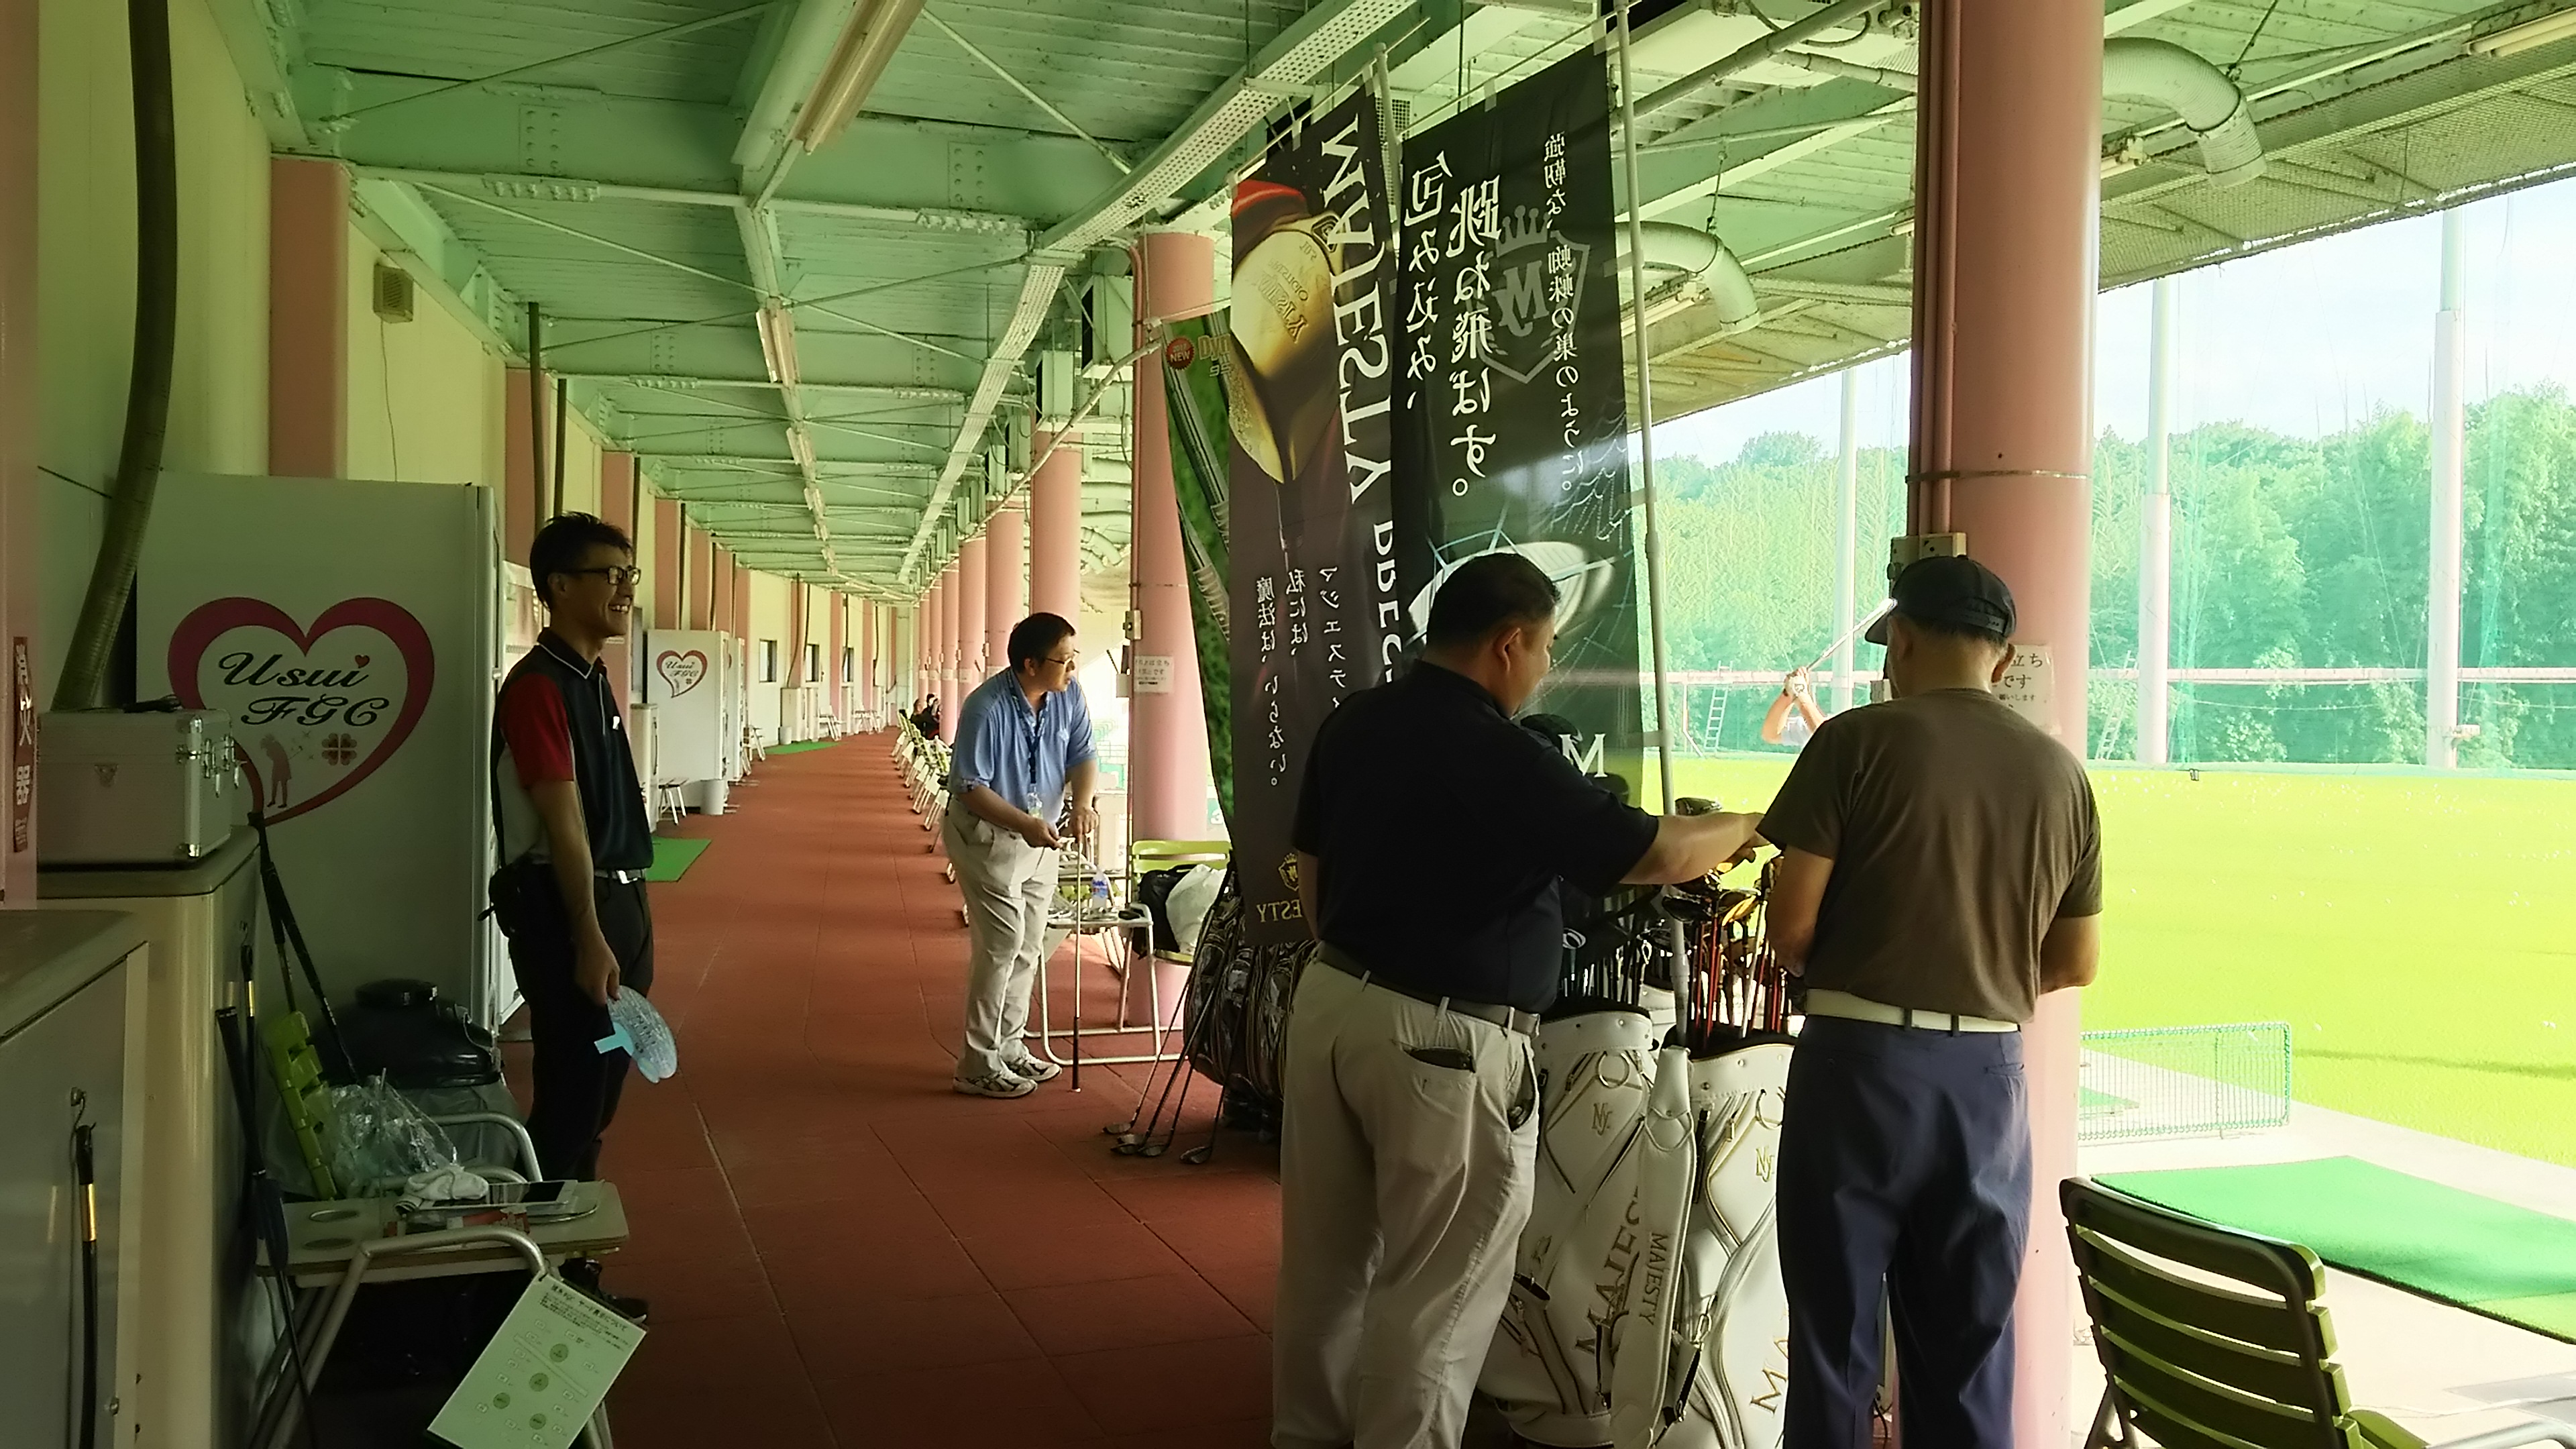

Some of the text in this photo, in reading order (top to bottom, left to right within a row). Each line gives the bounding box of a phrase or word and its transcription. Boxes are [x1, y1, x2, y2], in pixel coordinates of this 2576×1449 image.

[1170, 350, 1191, 362] NEW
[218, 651, 370, 688] Usui
[241, 693, 390, 727] FGC
[1639, 1232, 1669, 1326] MAJESTY
